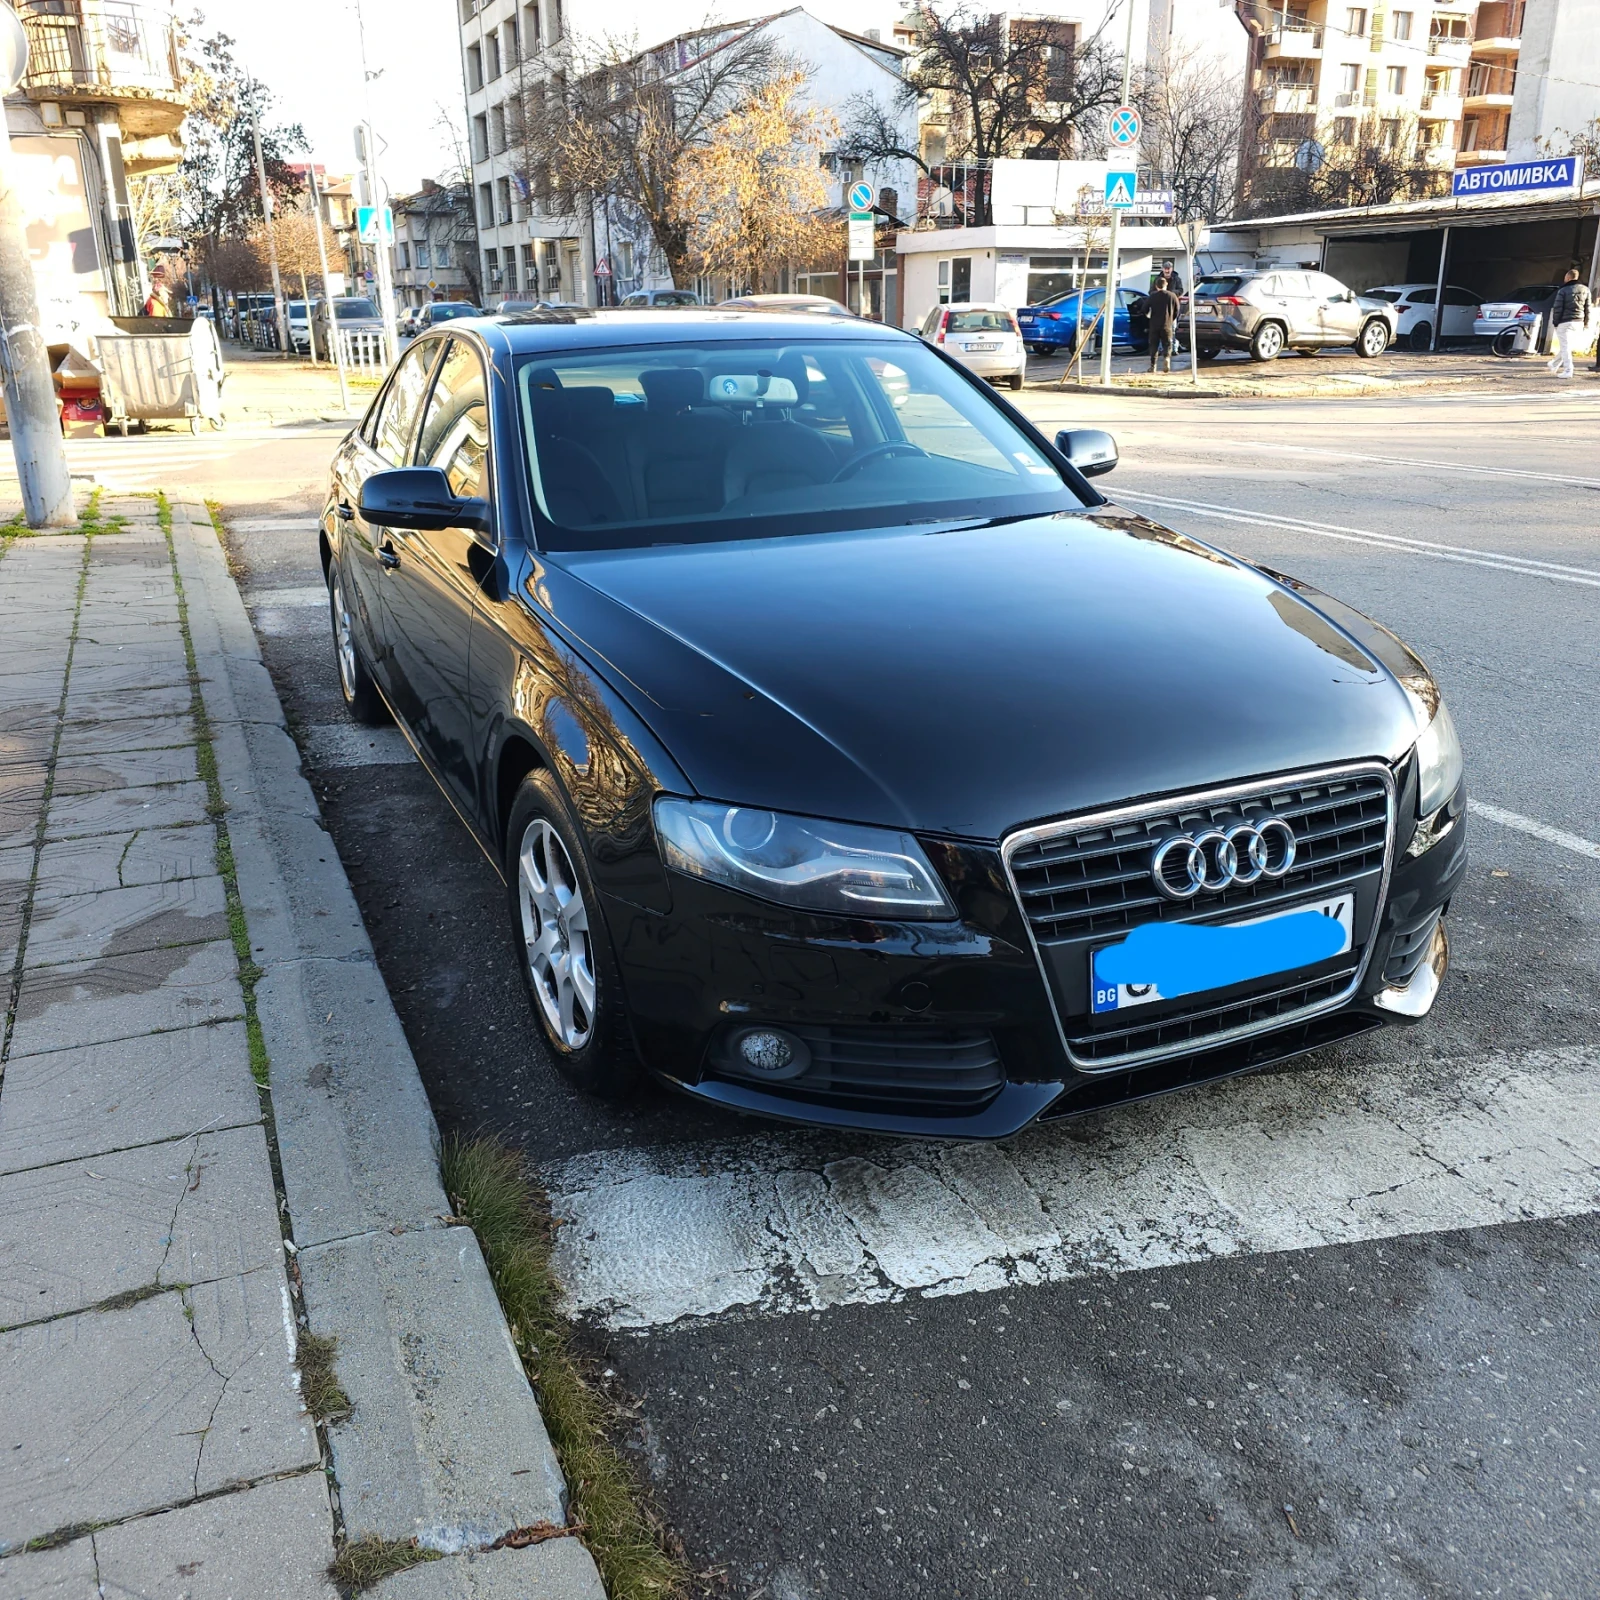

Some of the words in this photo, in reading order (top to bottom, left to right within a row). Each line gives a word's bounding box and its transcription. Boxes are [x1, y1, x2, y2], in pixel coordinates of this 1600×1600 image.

[1458, 164, 1568, 190] АВТОМИВКА
[1083, 191, 1169, 202] АВИВКА
[1097, 988, 1116, 1005] BG
